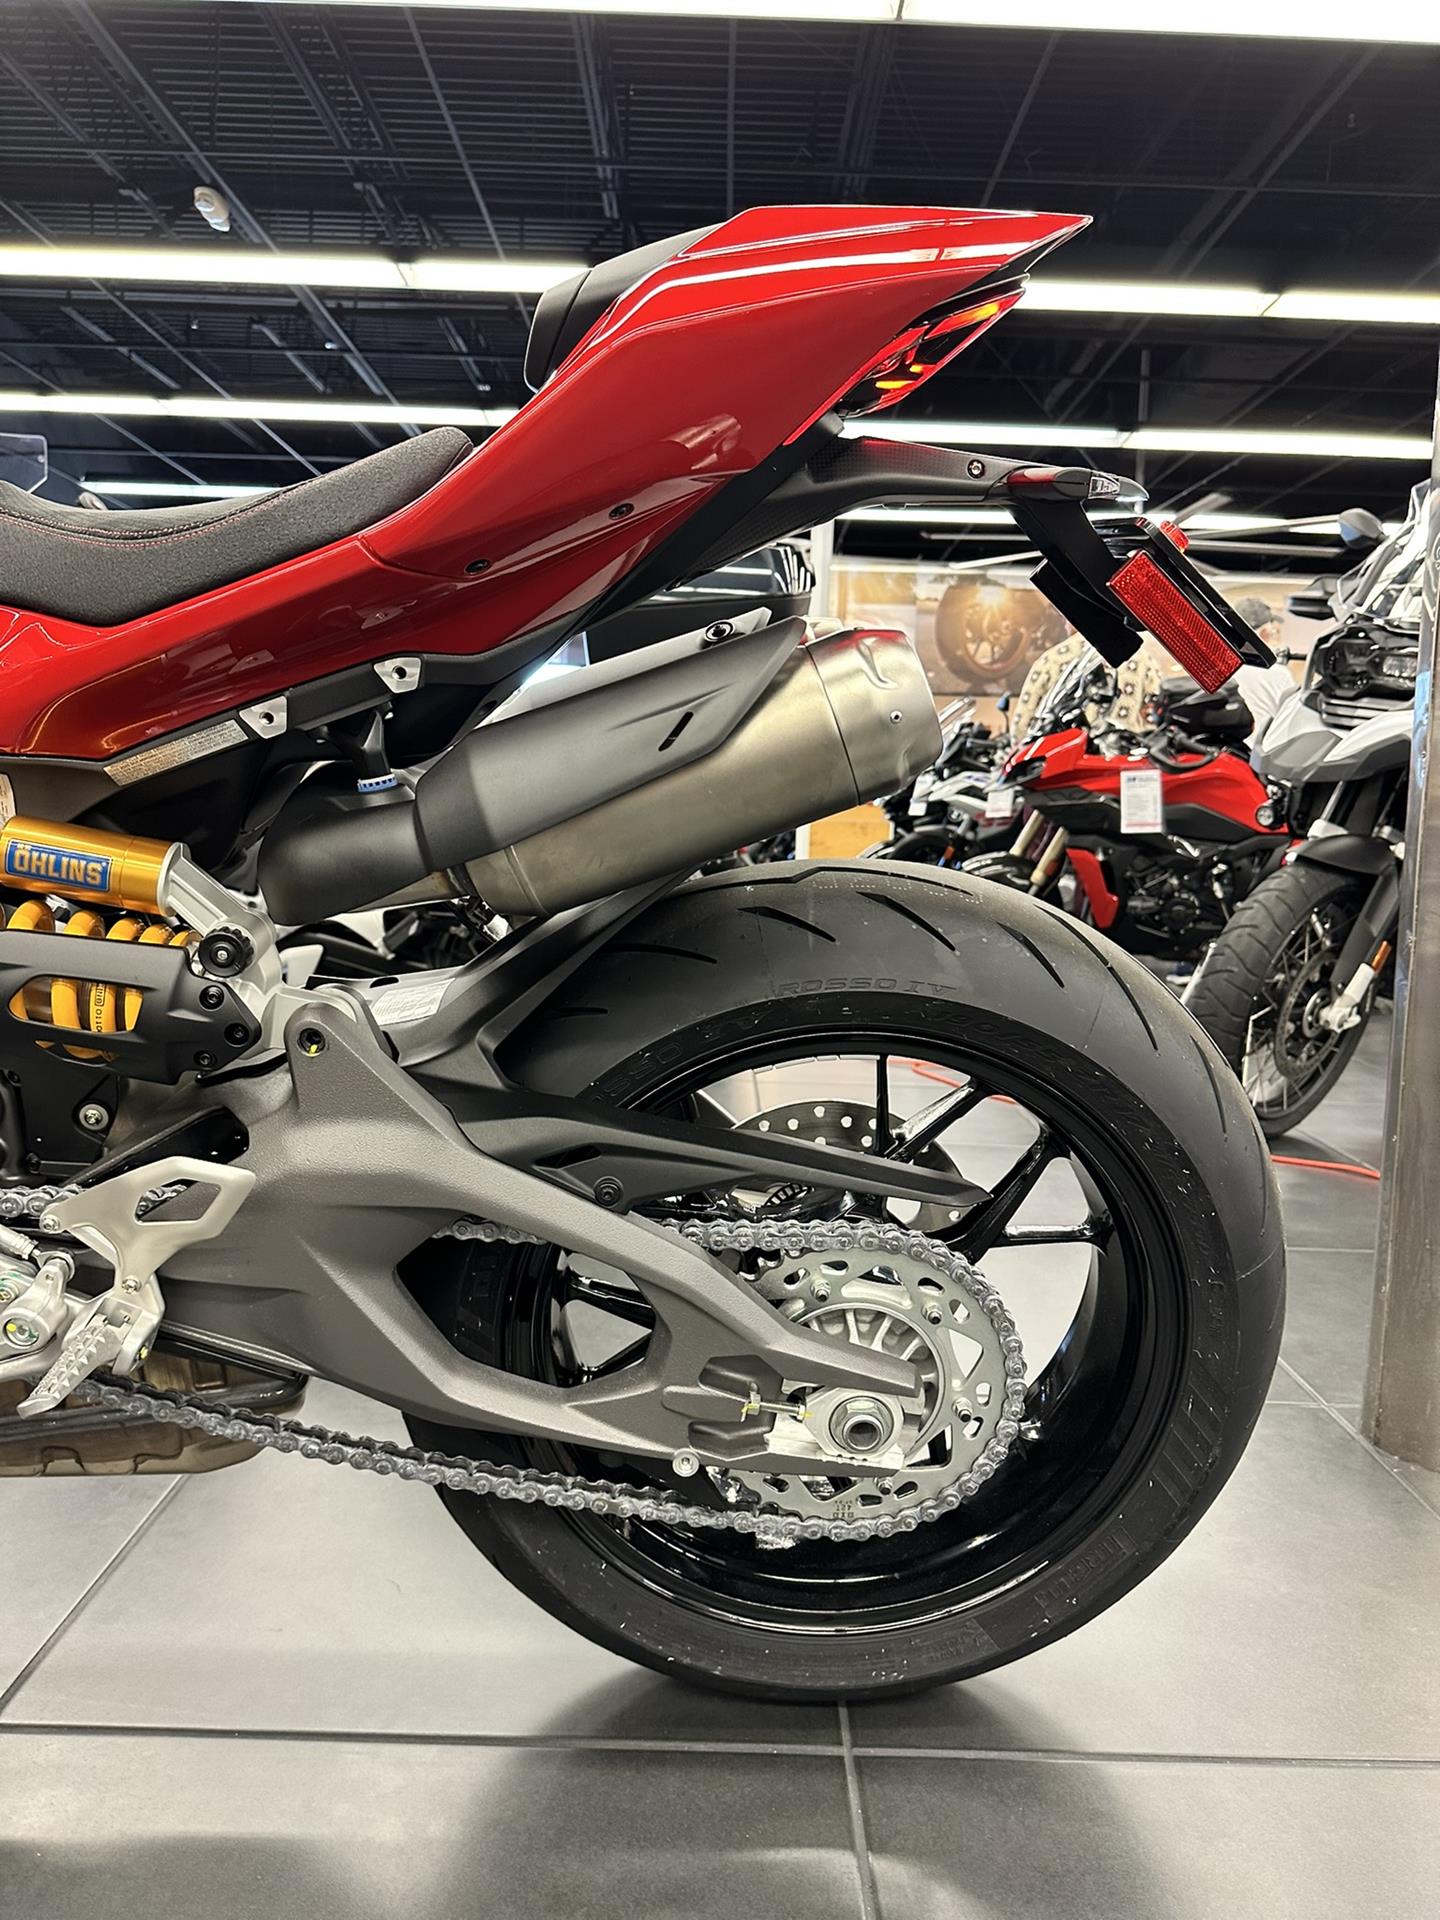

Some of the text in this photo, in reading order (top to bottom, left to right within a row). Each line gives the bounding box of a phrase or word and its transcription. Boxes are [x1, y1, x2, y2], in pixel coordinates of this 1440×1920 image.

[13, 844, 104, 887] ÖHLINS
[776, 977, 958, 996] ROSSO IV
